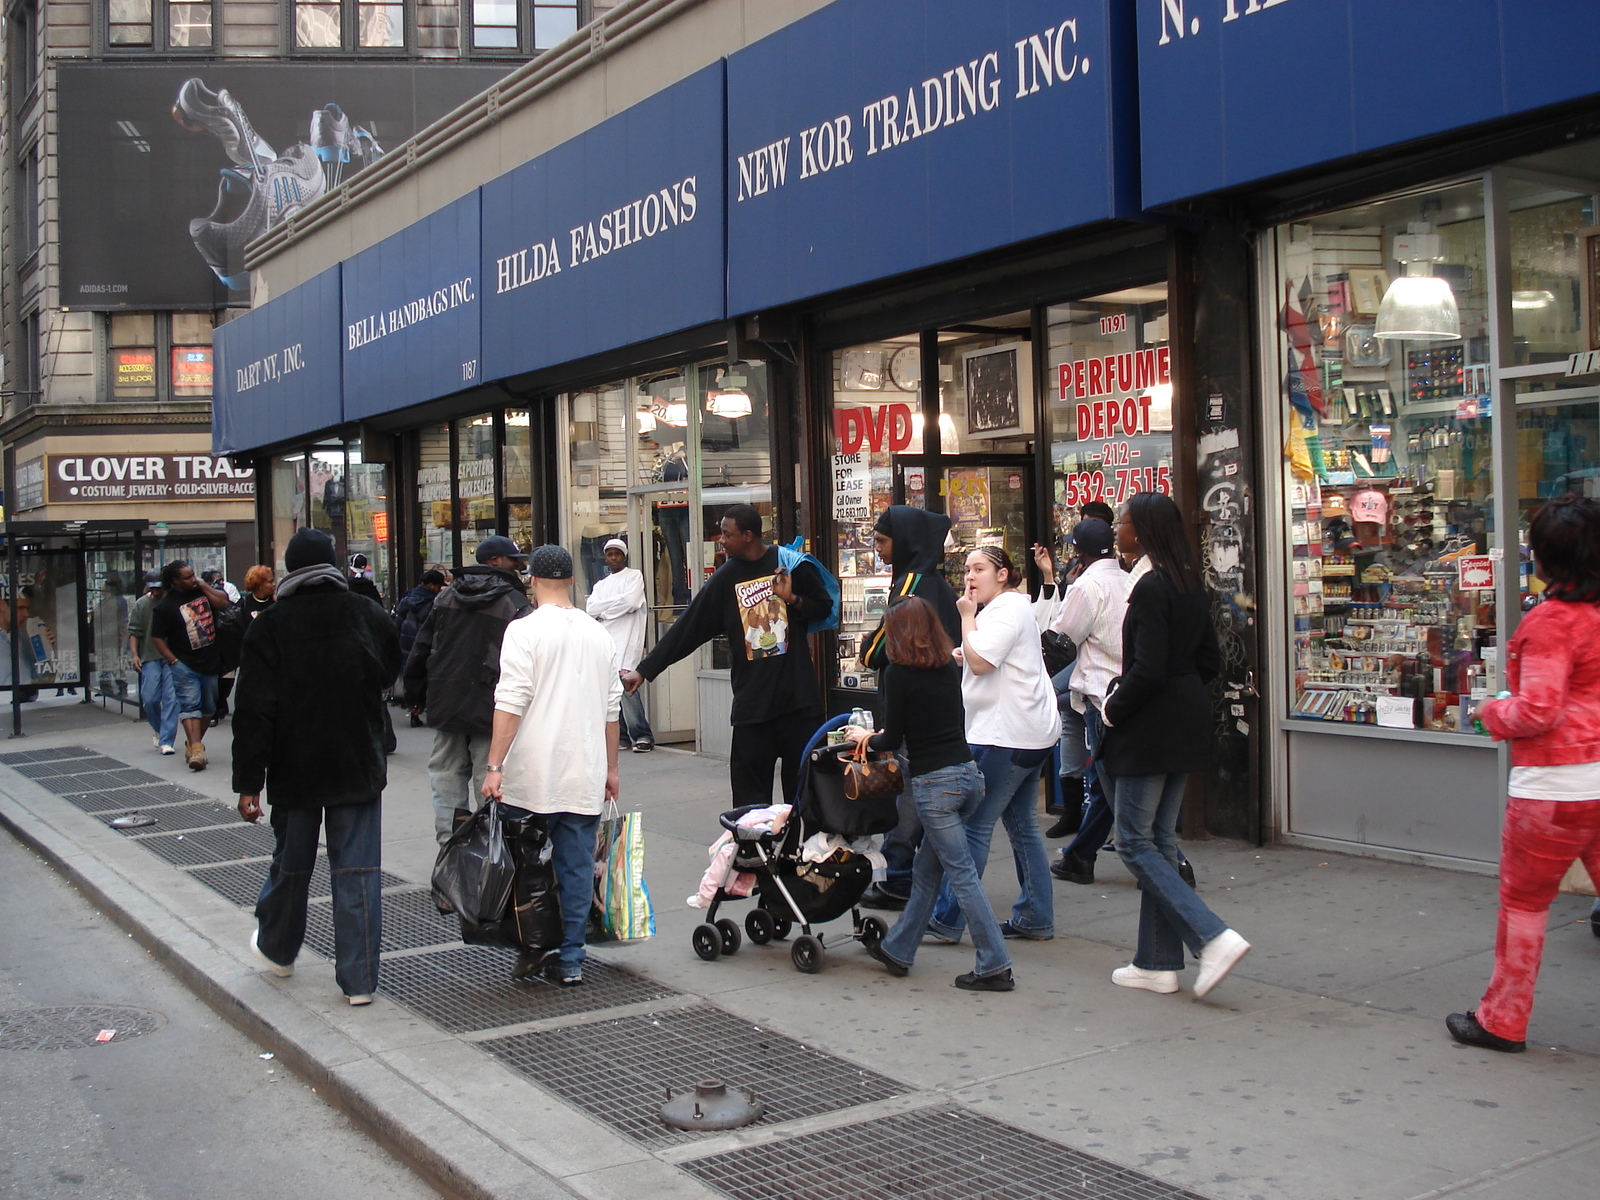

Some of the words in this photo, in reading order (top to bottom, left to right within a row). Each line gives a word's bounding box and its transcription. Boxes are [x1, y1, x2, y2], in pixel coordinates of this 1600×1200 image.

[1158, 0, 1200, 46] N.
[737, 136, 791, 202] NEW
[799, 115, 854, 180] KOR
[863, 51, 1001, 156] TRADING
[1015, 18, 1090, 99] INC.
[497, 237, 561, 294] HILDA
[569, 175, 697, 268] FASHIONS
[79, 284, 129, 294] ADIDAS-1.COM
[348, 311, 387, 350] BELLA
[388, 288, 448, 334] HANDBAGS
[449, 276, 475, 309] INC.
[1100, 313, 1127, 335] 1191
[119, 364, 153, 373] ACCESSORIES
[236, 359, 261, 393] DART
[263, 353, 281, 383] NY,
[283, 343, 305, 374] INC.
[462, 359, 477, 381] 1187
[1058, 346, 1171, 401] PERFUME
[1569, 351, 1600, 375] 11
[842, 403, 913, 455] DVD
[1076, 396, 1152, 442] DEPOT
[58, 457, 166, 481] CLOVER
[835, 453, 862, 466] STORE
[835, 468, 853, 480] FOR
[81, 485, 126, 497] COSTUME
[126, 484, 168, 499] JEWELRY
[174, 483, 198, 495] GOLD
[836, 479, 863, 492] LEASE
[1066, 467, 1170, 508] 532-7515
[836, 495, 845, 506] Call
[845, 495, 862, 505] Owner
[1461, 559, 1491, 570] Special
[737, 579, 773, 597] Golden
[740, 587, 774, 608] Grams
[51, 650, 77, 661] LIFE
[34, 662, 78, 674] TAKES
[59, 672, 78, 681] VISA
